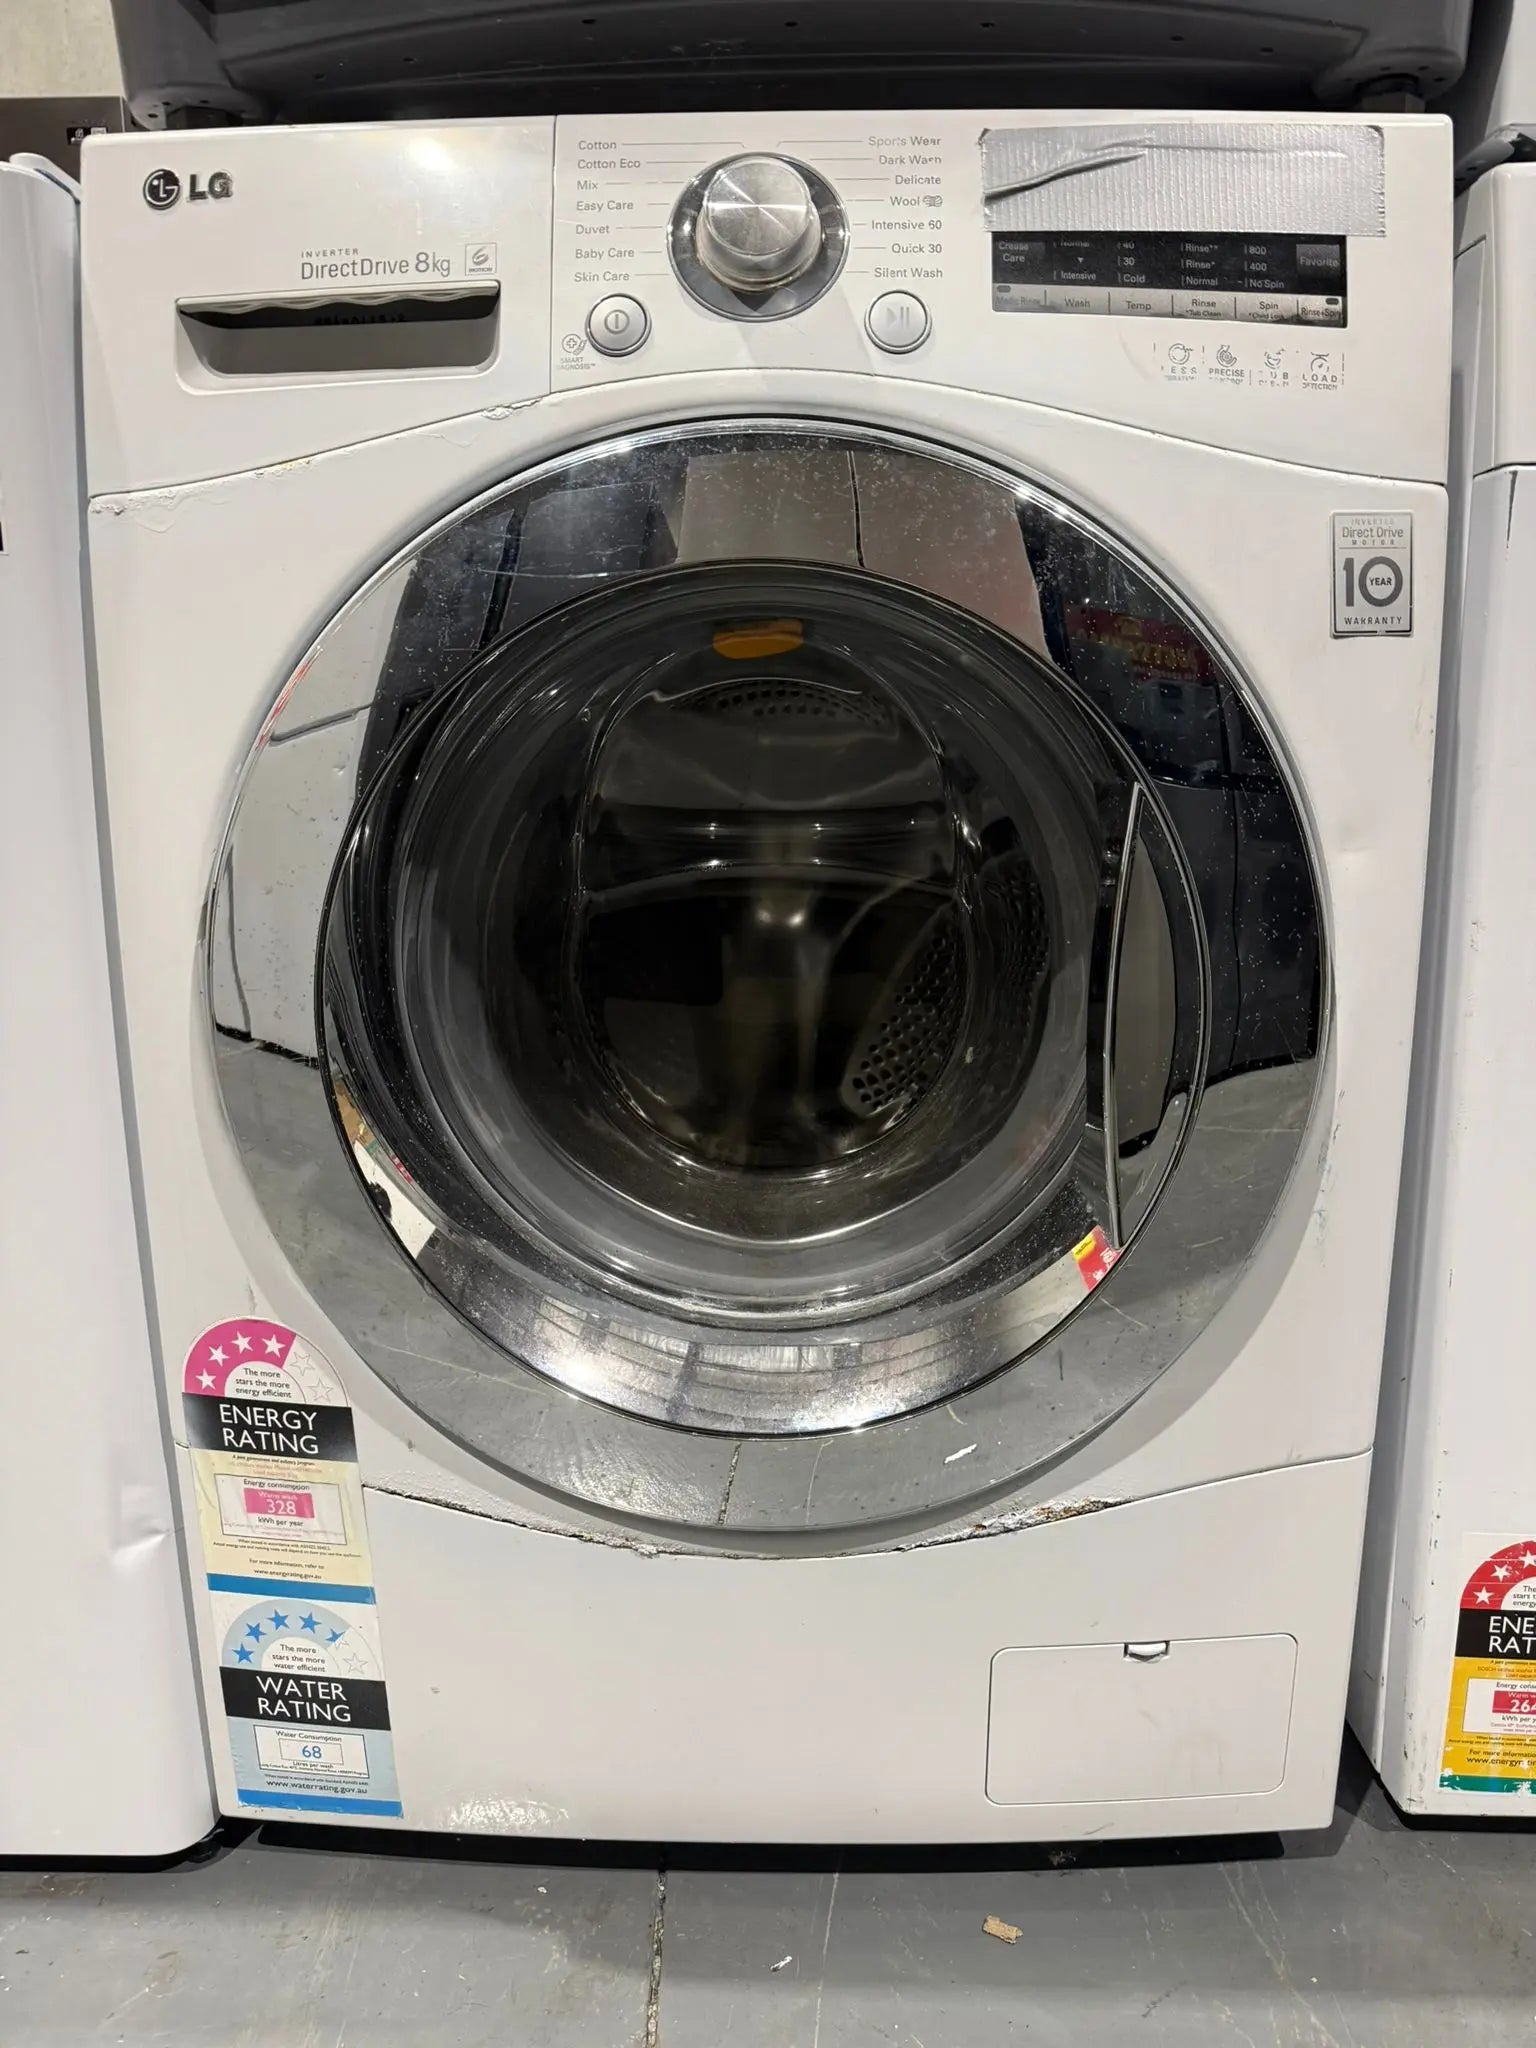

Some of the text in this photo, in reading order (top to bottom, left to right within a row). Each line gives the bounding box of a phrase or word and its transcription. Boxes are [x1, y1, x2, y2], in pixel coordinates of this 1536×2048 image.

[578, 140, 617, 151] Cotton
[910, 136, 942, 146] Wear
[577, 158, 641, 169] Cotton Eco
[879, 155, 906, 165] Dark
[189, 171, 233, 199] LG
[576, 180, 599, 190] Mix
[895, 175, 942, 185] Delicate
[576, 200, 634, 213] Easy Care
[890, 196, 920, 207] Wool
[575, 224, 610, 235] Duvet
[871, 220, 942, 230] Intensive 60
[301, 248, 359, 258] INVERTER
[575, 247, 634, 260] Baby Care
[891, 243, 942, 254] Quick 30
[1250, 246, 1267, 255] 800
[1002, 253, 1026, 263] Care
[1123, 256, 1135, 266] 30
[1300, 256, 1339, 268] Favorite
[874, 267, 943, 278] Silent Wash
[1250, 263, 1267, 272] 400
[574, 271, 630, 283] Skin Care
[1061, 271, 1096, 281] Intensive
[1123, 274, 1145, 284] Cold
[1186, 277, 1218, 287] Normal
[1264, 280, 1285, 291] Spin
[1064, 297, 1090, 308] Wash
[1125, 301, 1152, 311] Temp
[1191, 299, 1216, 308] Rinse
[1259, 301, 1279, 311] Spin
[1208, 367, 1245, 378] PRECISE
[1302, 373, 1338, 383] LOAD
[1342, 527, 1404, 538] Direct Drive
[1343, 556, 1403, 608] 10
[1368, 577, 1393, 586] YEAR
[1344, 616, 1402, 625] WARRANTY
[243, 1368, 258, 1376] The
[235, 1378, 290, 1389] stars the more
[235, 1388, 292, 1398] energy efficient
[219, 1403, 317, 1431] ENERGY
[222, 1427, 319, 1454] RATING
[243, 1478, 310, 1491] Energy consumption
[257, 1490, 280, 1498] Warm
[267, 1500, 297, 1516] 328
[276, 1519, 287, 1527] per
[1488, 1615, 1536, 1634] ENE
[280, 1643, 295, 1652] The
[1488, 1635, 1536, 1654] RAT
[272, 1653, 290, 1661] stars
[291, 1655, 304, 1663] the
[274, 1662, 326, 1672] water efficient
[256, 1675, 347, 1701] WATER
[1496, 1681, 1517, 1689] Energy
[257, 1697, 351, 1722] RATING
[275, 1730, 342, 1742] Water Consumption
[302, 1745, 322, 1759] 68
[266, 1780, 368, 1794] www.waterrating.gov.au
